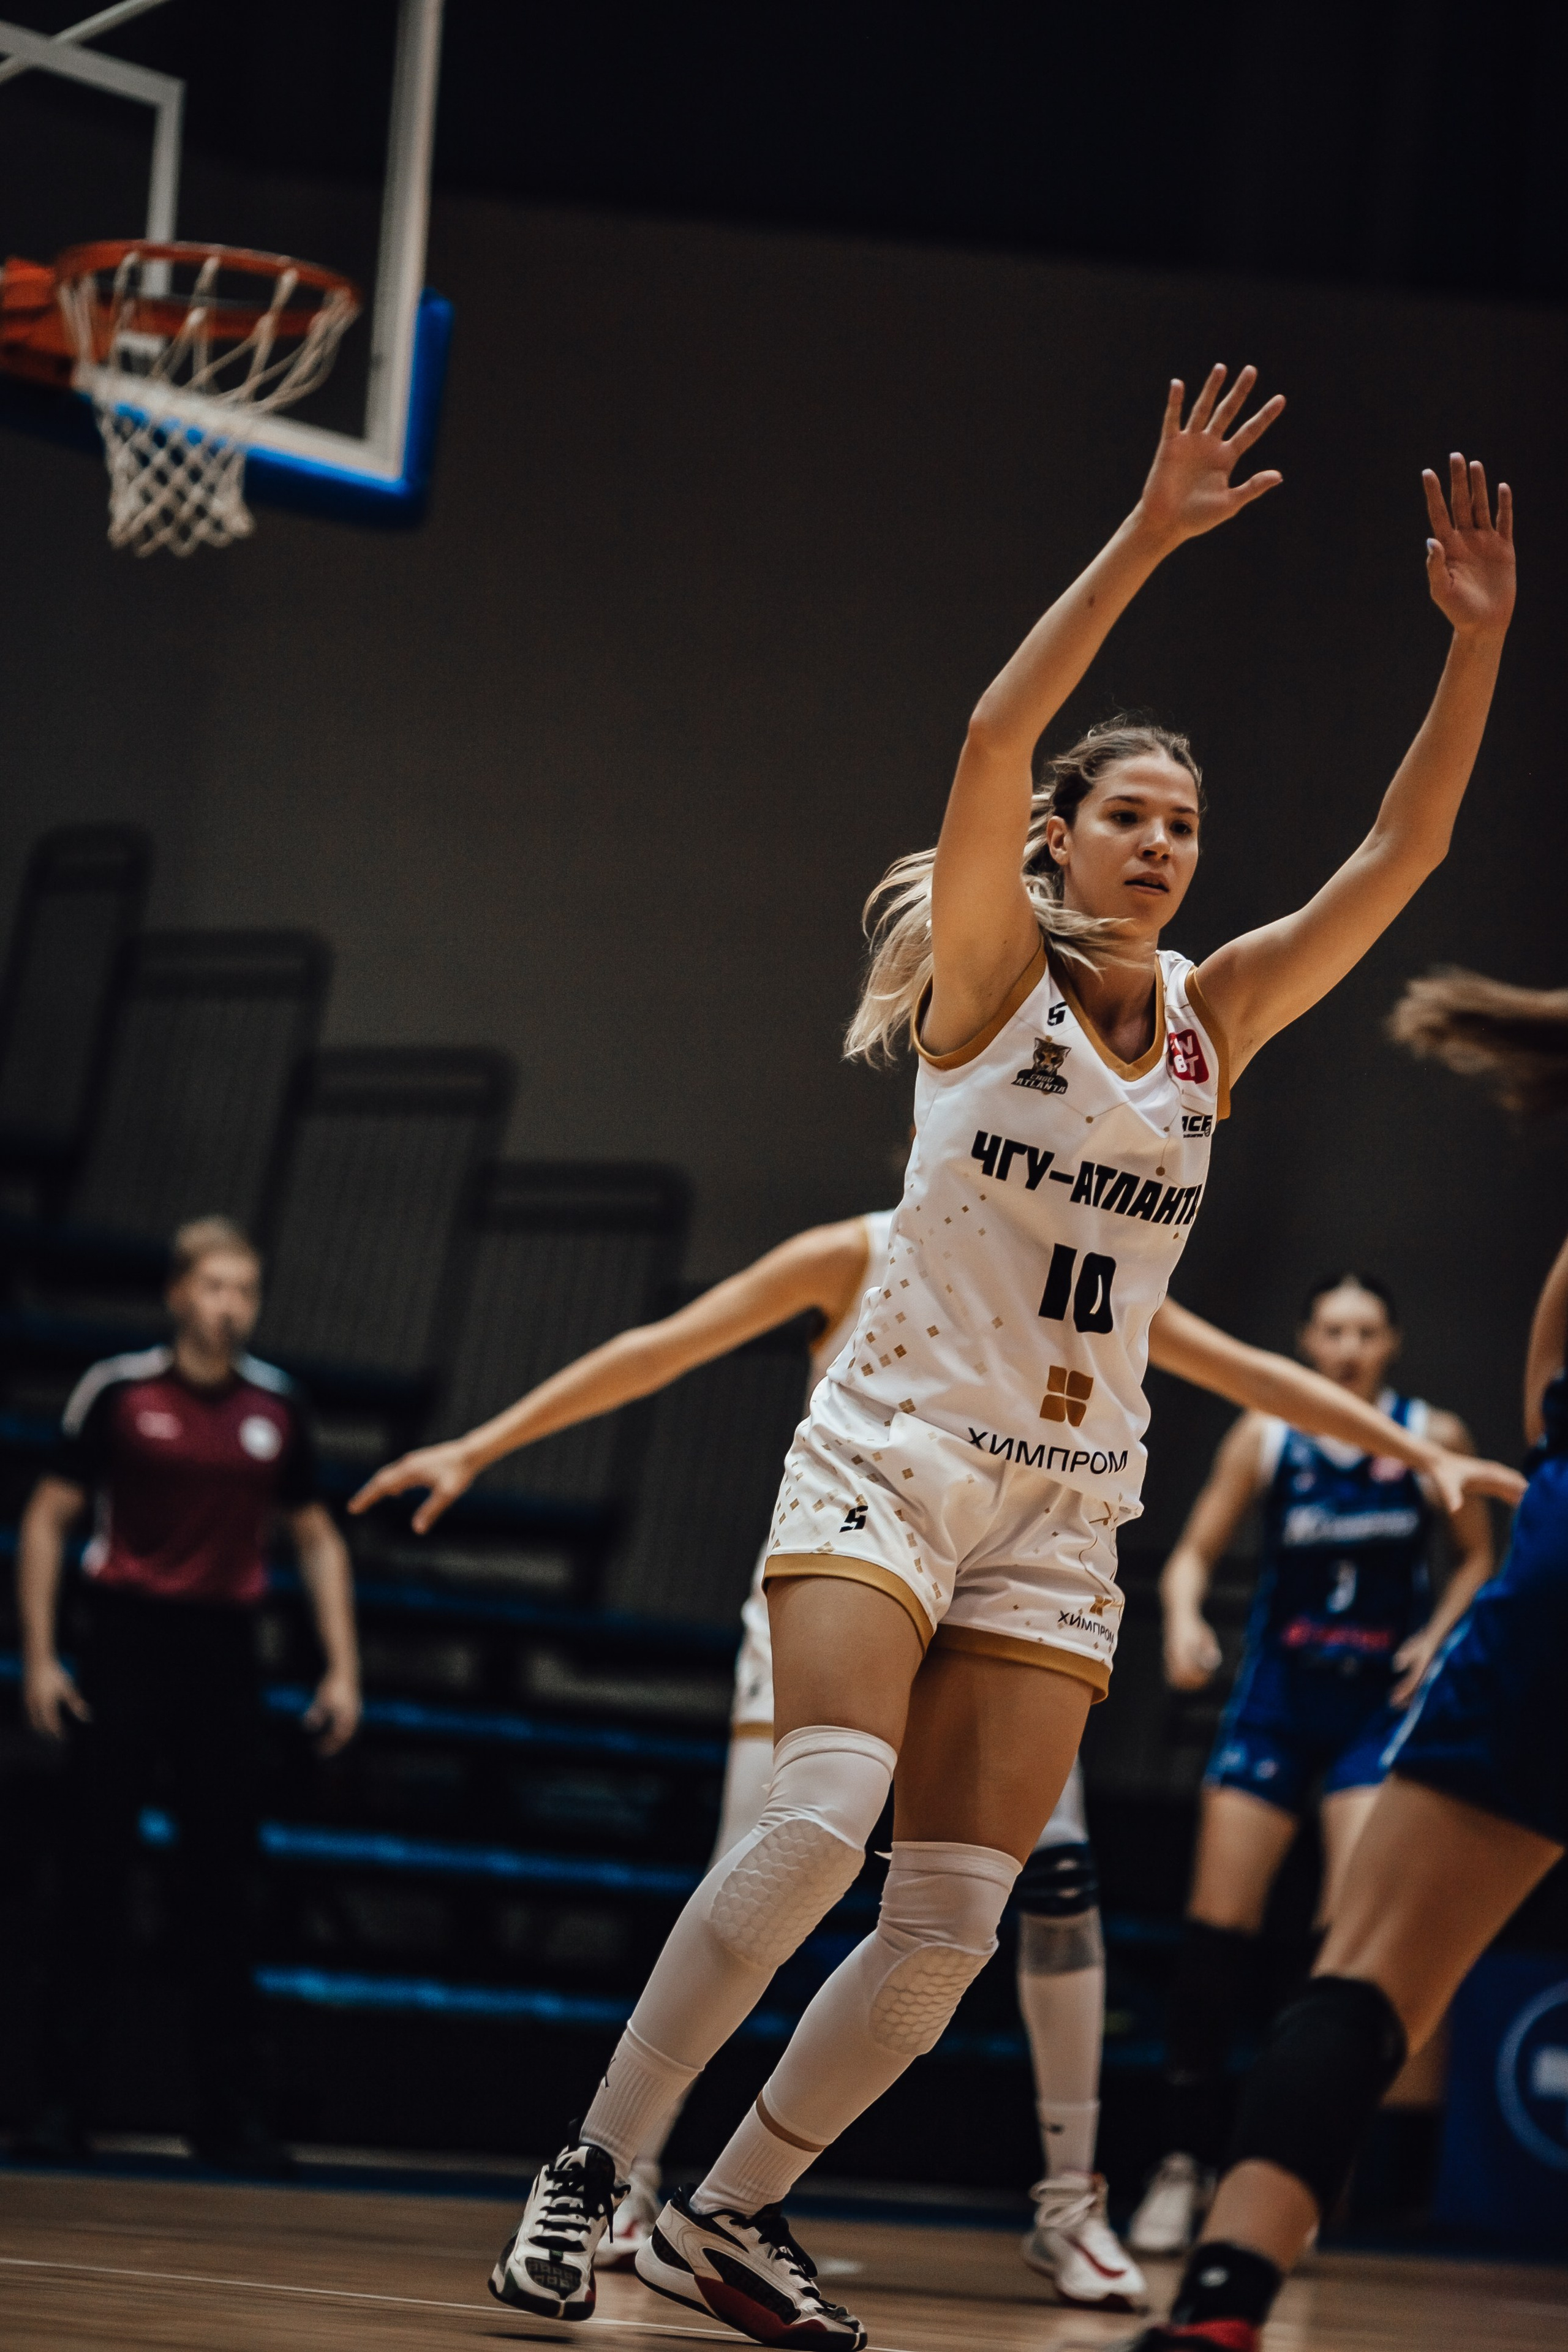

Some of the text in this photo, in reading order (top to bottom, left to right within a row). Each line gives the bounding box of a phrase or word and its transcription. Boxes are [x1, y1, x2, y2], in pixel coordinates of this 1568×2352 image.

[1016, 1077, 1066, 1093] ATLANTA
[1038, 1243, 1117, 1334] 10
[968, 1427, 1129, 1475] ХИМПРОМ
